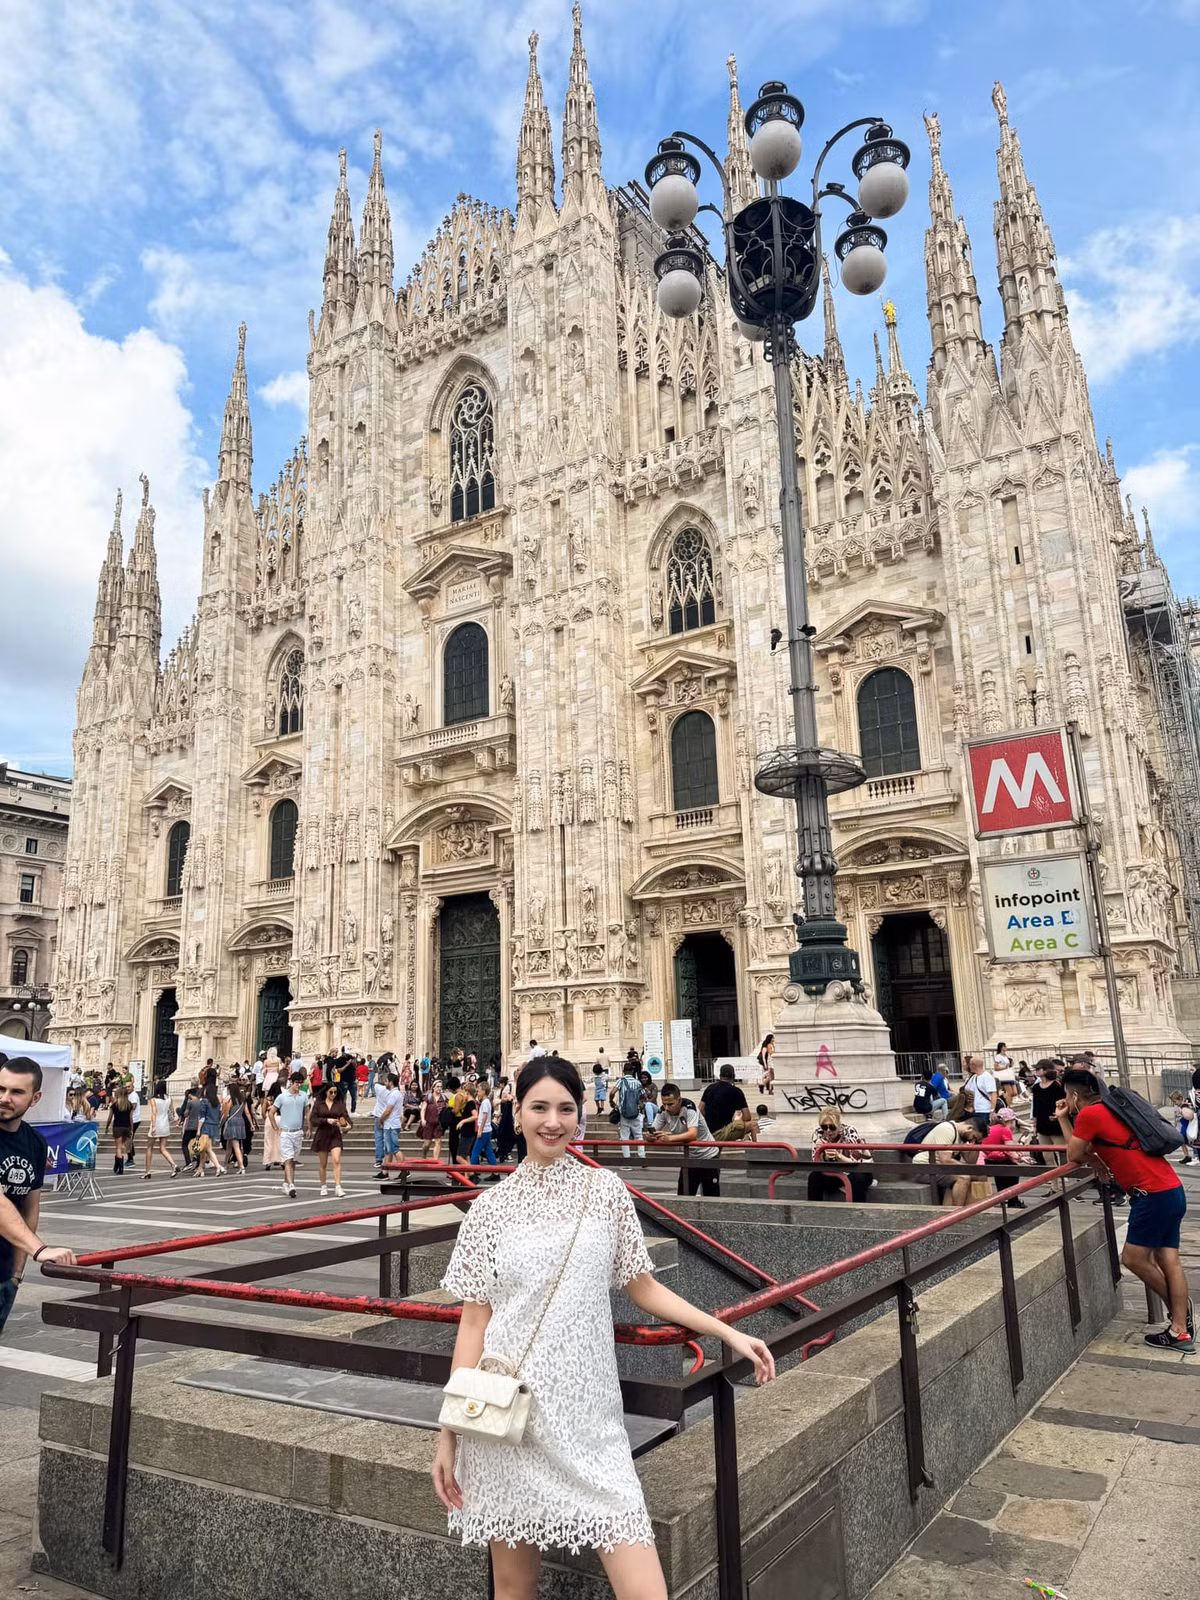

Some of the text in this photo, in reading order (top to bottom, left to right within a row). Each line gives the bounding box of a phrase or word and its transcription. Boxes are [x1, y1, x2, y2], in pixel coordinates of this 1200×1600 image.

[981, 752, 1065, 813] M
[995, 889, 1080, 908] infopoint
[1007, 915, 1054, 929] Area
[1010, 933, 1078, 952] Area C
